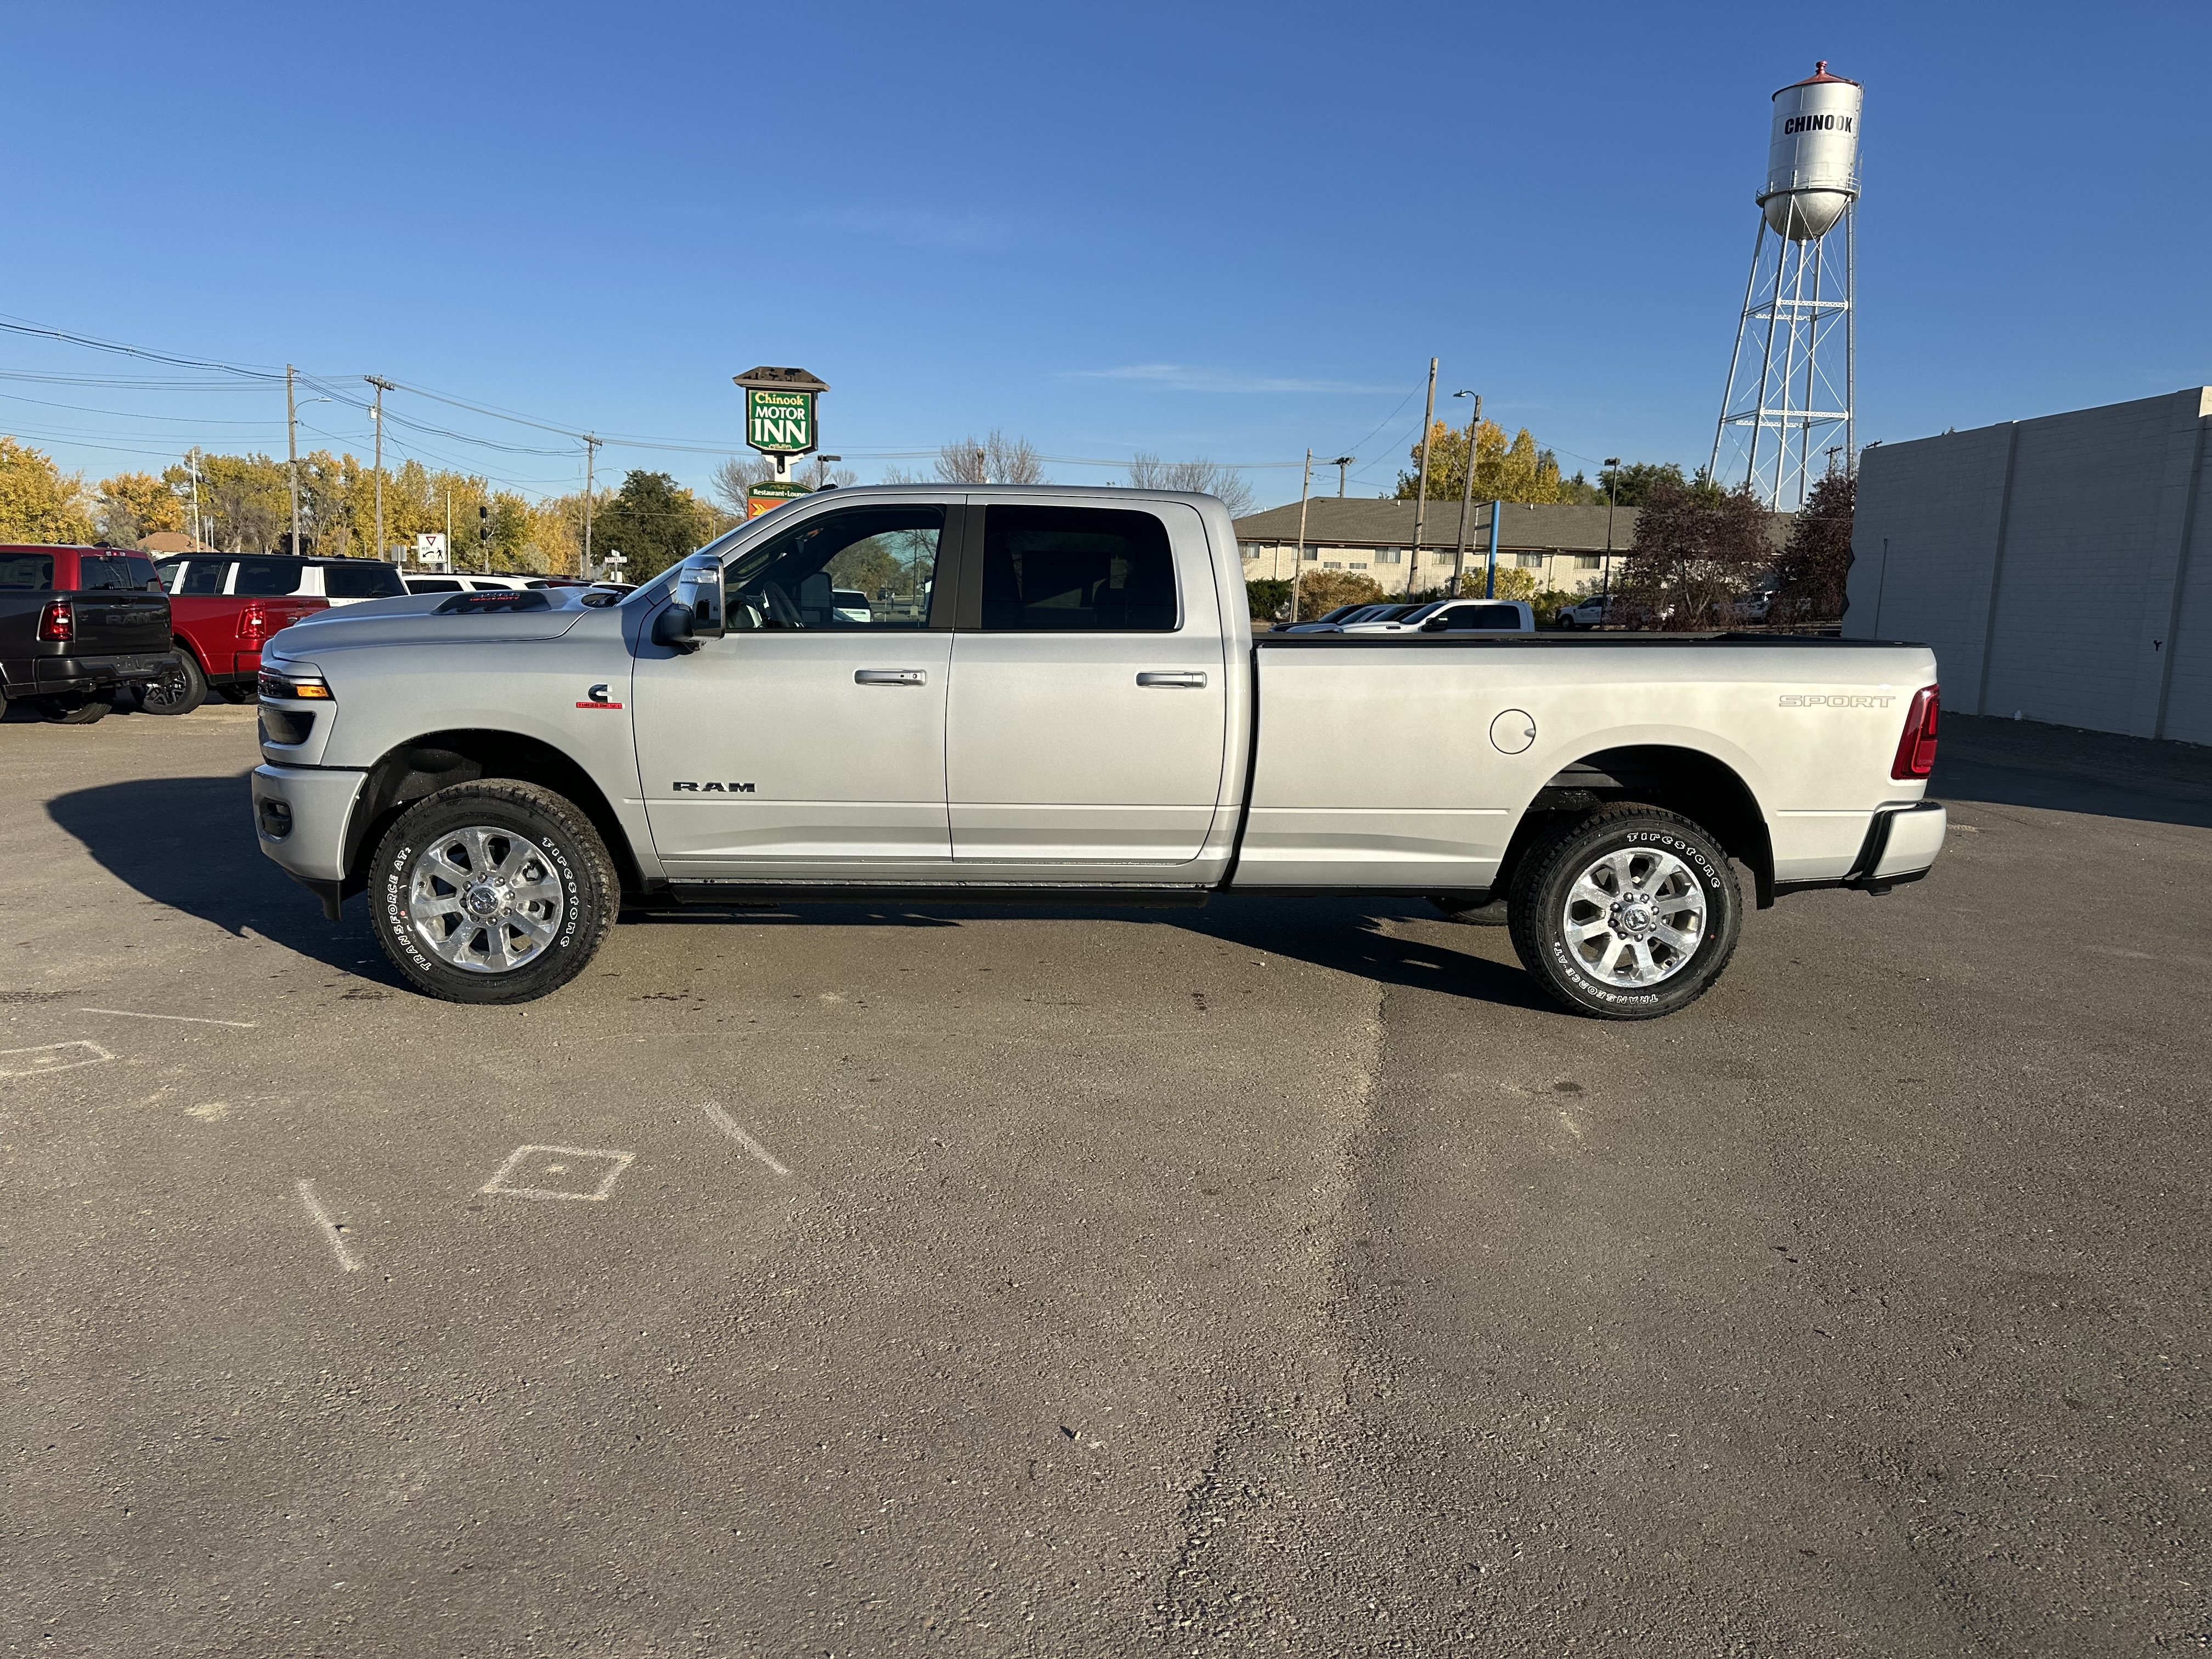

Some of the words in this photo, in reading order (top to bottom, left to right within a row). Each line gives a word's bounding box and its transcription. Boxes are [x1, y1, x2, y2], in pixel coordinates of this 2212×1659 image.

[1785, 115, 1853, 135] CHINOOK
[755, 392, 804, 405] Chinook
[755, 406, 805, 420] MOTOR
[755, 418, 806, 444] INN
[106, 613, 151, 624] RAM
[1779, 695, 1896, 708] SPORT
[673, 782, 757, 793] RAM
[387, 874, 431, 971] TRANSFORCE
[1565, 967, 1658, 1005] TRANSFORCE
